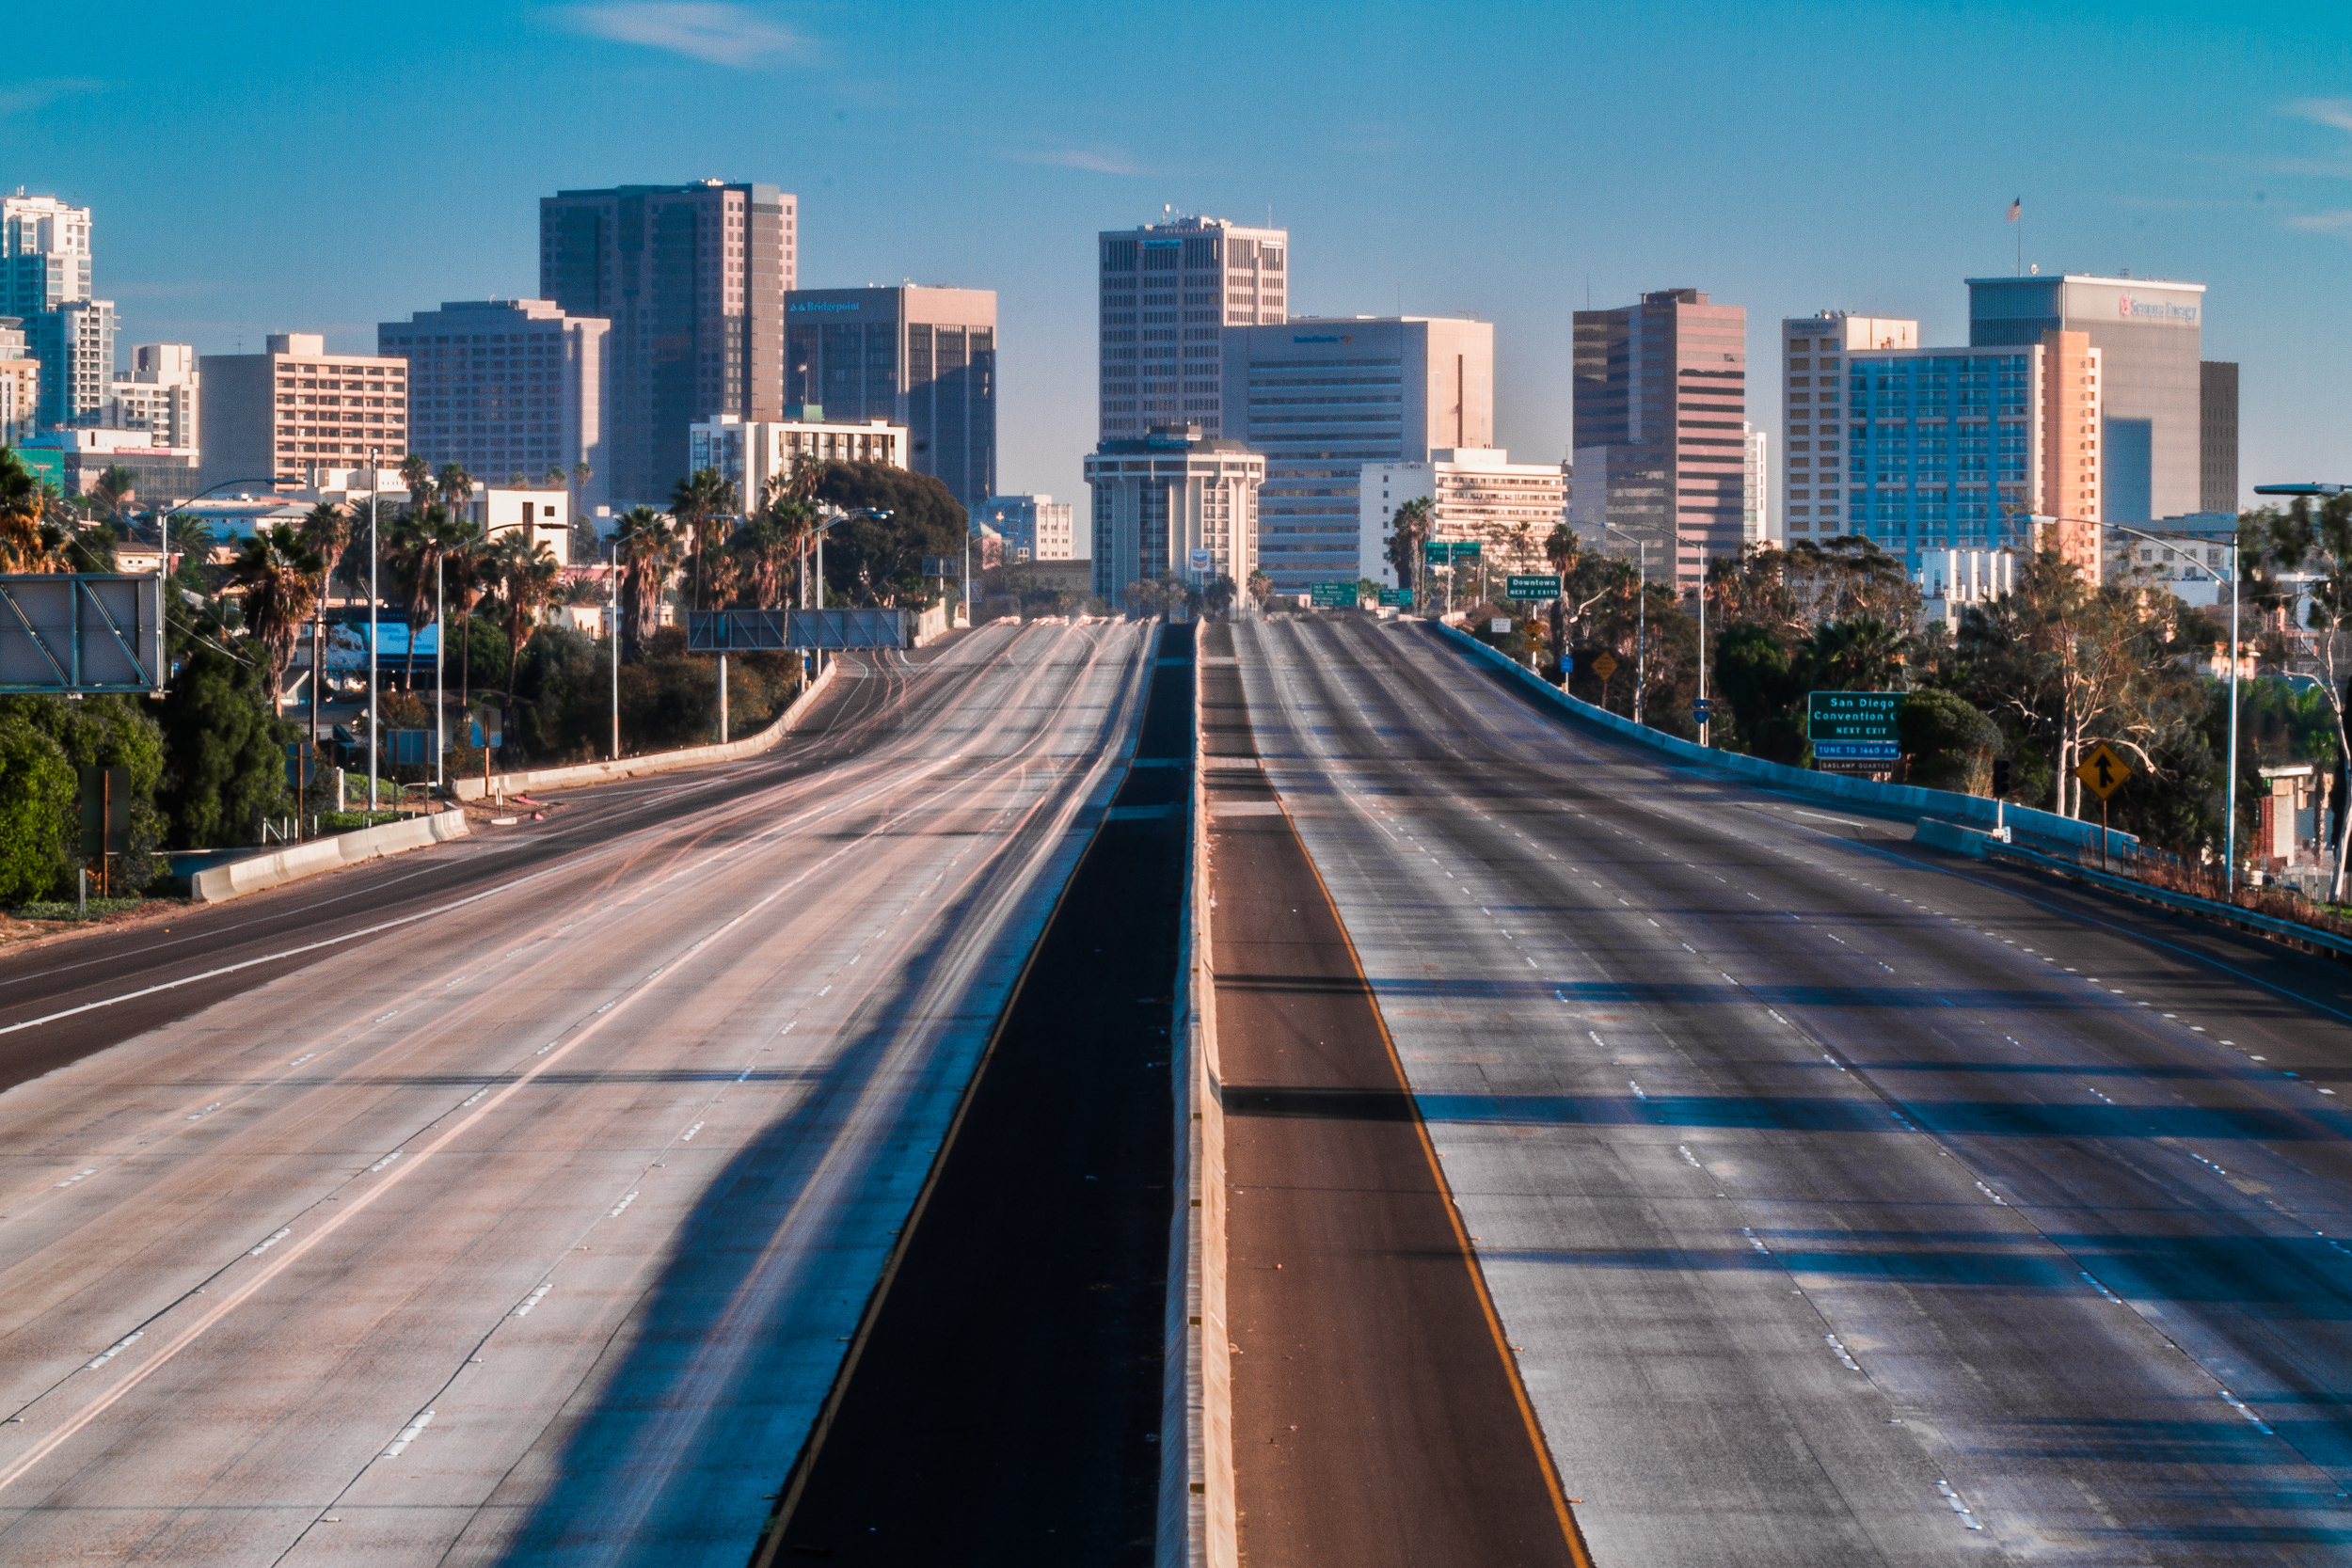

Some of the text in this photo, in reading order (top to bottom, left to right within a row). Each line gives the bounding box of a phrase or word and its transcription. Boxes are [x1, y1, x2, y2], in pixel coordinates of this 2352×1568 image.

[806, 300, 860, 313] Bridgepoint
[1830, 698, 1895, 710] San Diego
[1814, 711, 1883, 721] Convention
